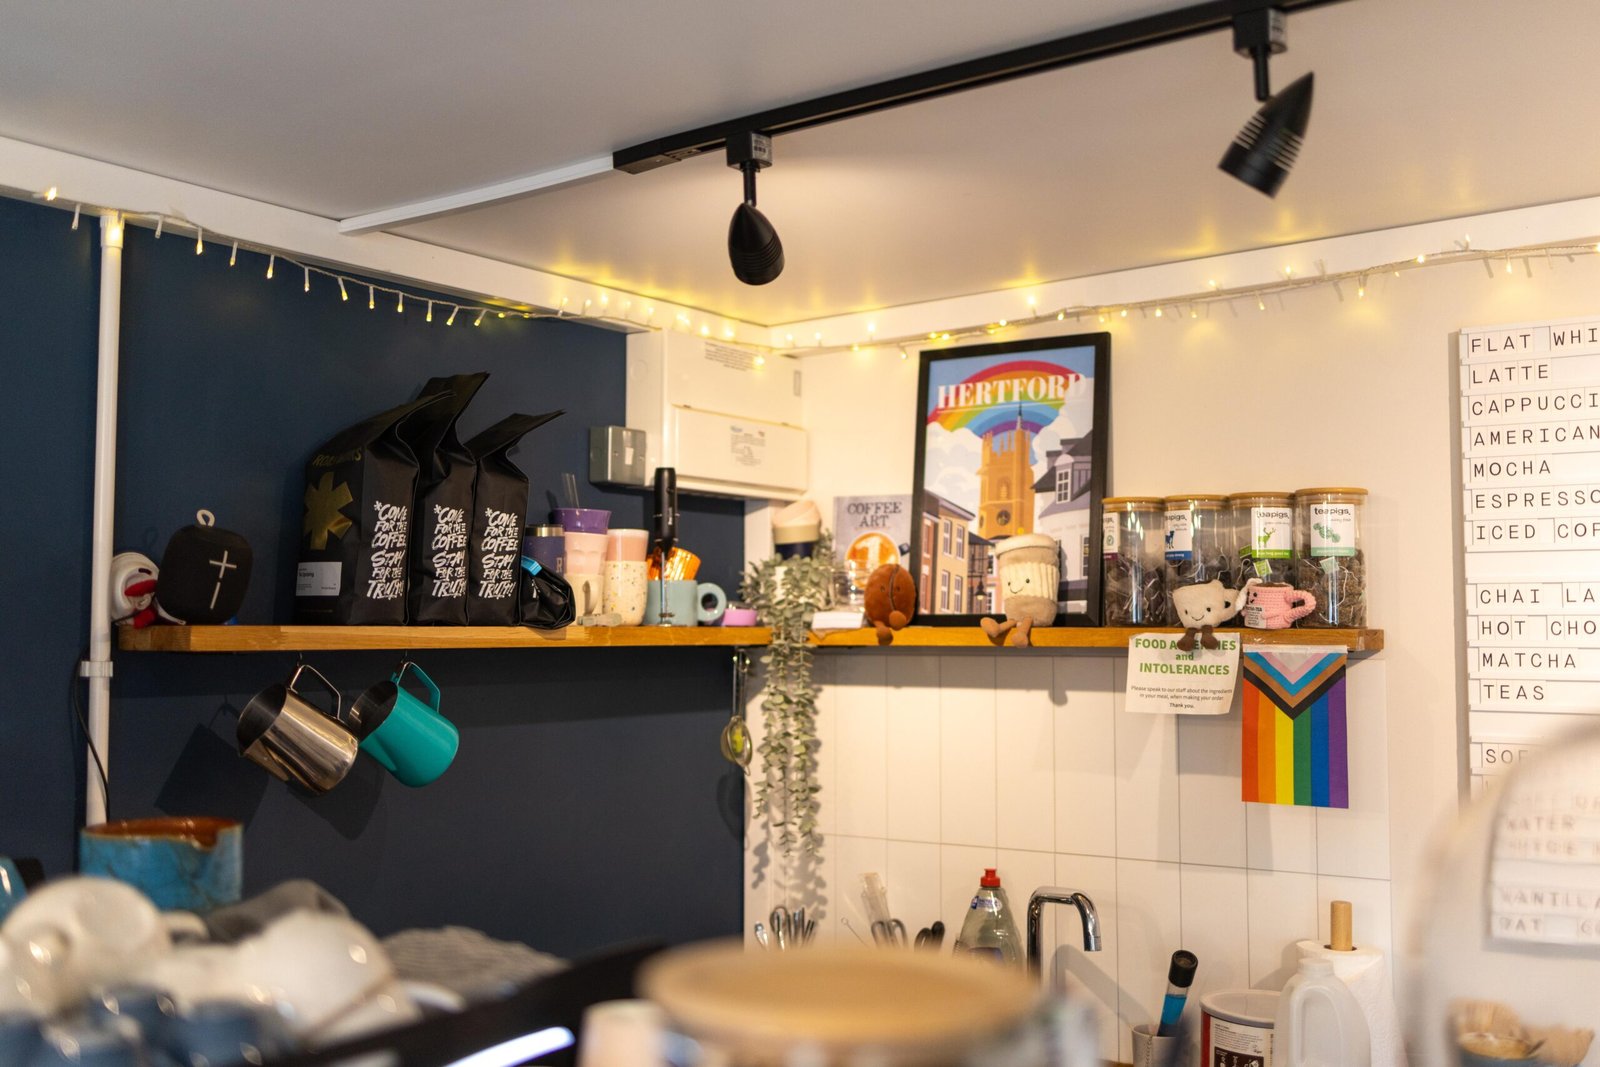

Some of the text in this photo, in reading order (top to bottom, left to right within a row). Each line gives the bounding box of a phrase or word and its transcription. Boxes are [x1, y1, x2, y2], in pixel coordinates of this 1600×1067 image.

[1471, 327, 1598, 353] FLAT WHI
[1472, 364, 1549, 384] LATTE
[938, 373, 1088, 409] HERTFORD
[1471, 392, 1599, 416] CAPPUCCI
[1473, 424, 1600, 447] AMERICAN
[1474, 459, 1551, 478] MOCHA
[1475, 488, 1600, 509] ESPRESSO
[847, 501, 903, 515] COFFEE
[374, 520, 396, 532] FOR
[434, 522, 466, 535] FOR THE
[859, 514, 889, 528] ART
[483, 526, 519, 538] FOR THE
[1476, 524, 1537, 541] ICED
[370, 549, 406, 567] STAY
[432, 550, 466, 567] STAY
[481, 552, 517, 569] STAY
[371, 567, 391, 579] FOR
[435, 567, 454, 579] FOR
[483, 568, 513, 580] FOR THE
[1479, 588, 1596, 605] CHAI LA
[1481, 620, 1597, 636] HOT CHO
[1135, 638, 1167, 650] FOOD
[1175, 652, 1194, 661] and
[1481, 652, 1577, 669] MATCHA
[1139, 662, 1230, 675] INTOLERANCES
[1483, 684, 1545, 701] TEAS
